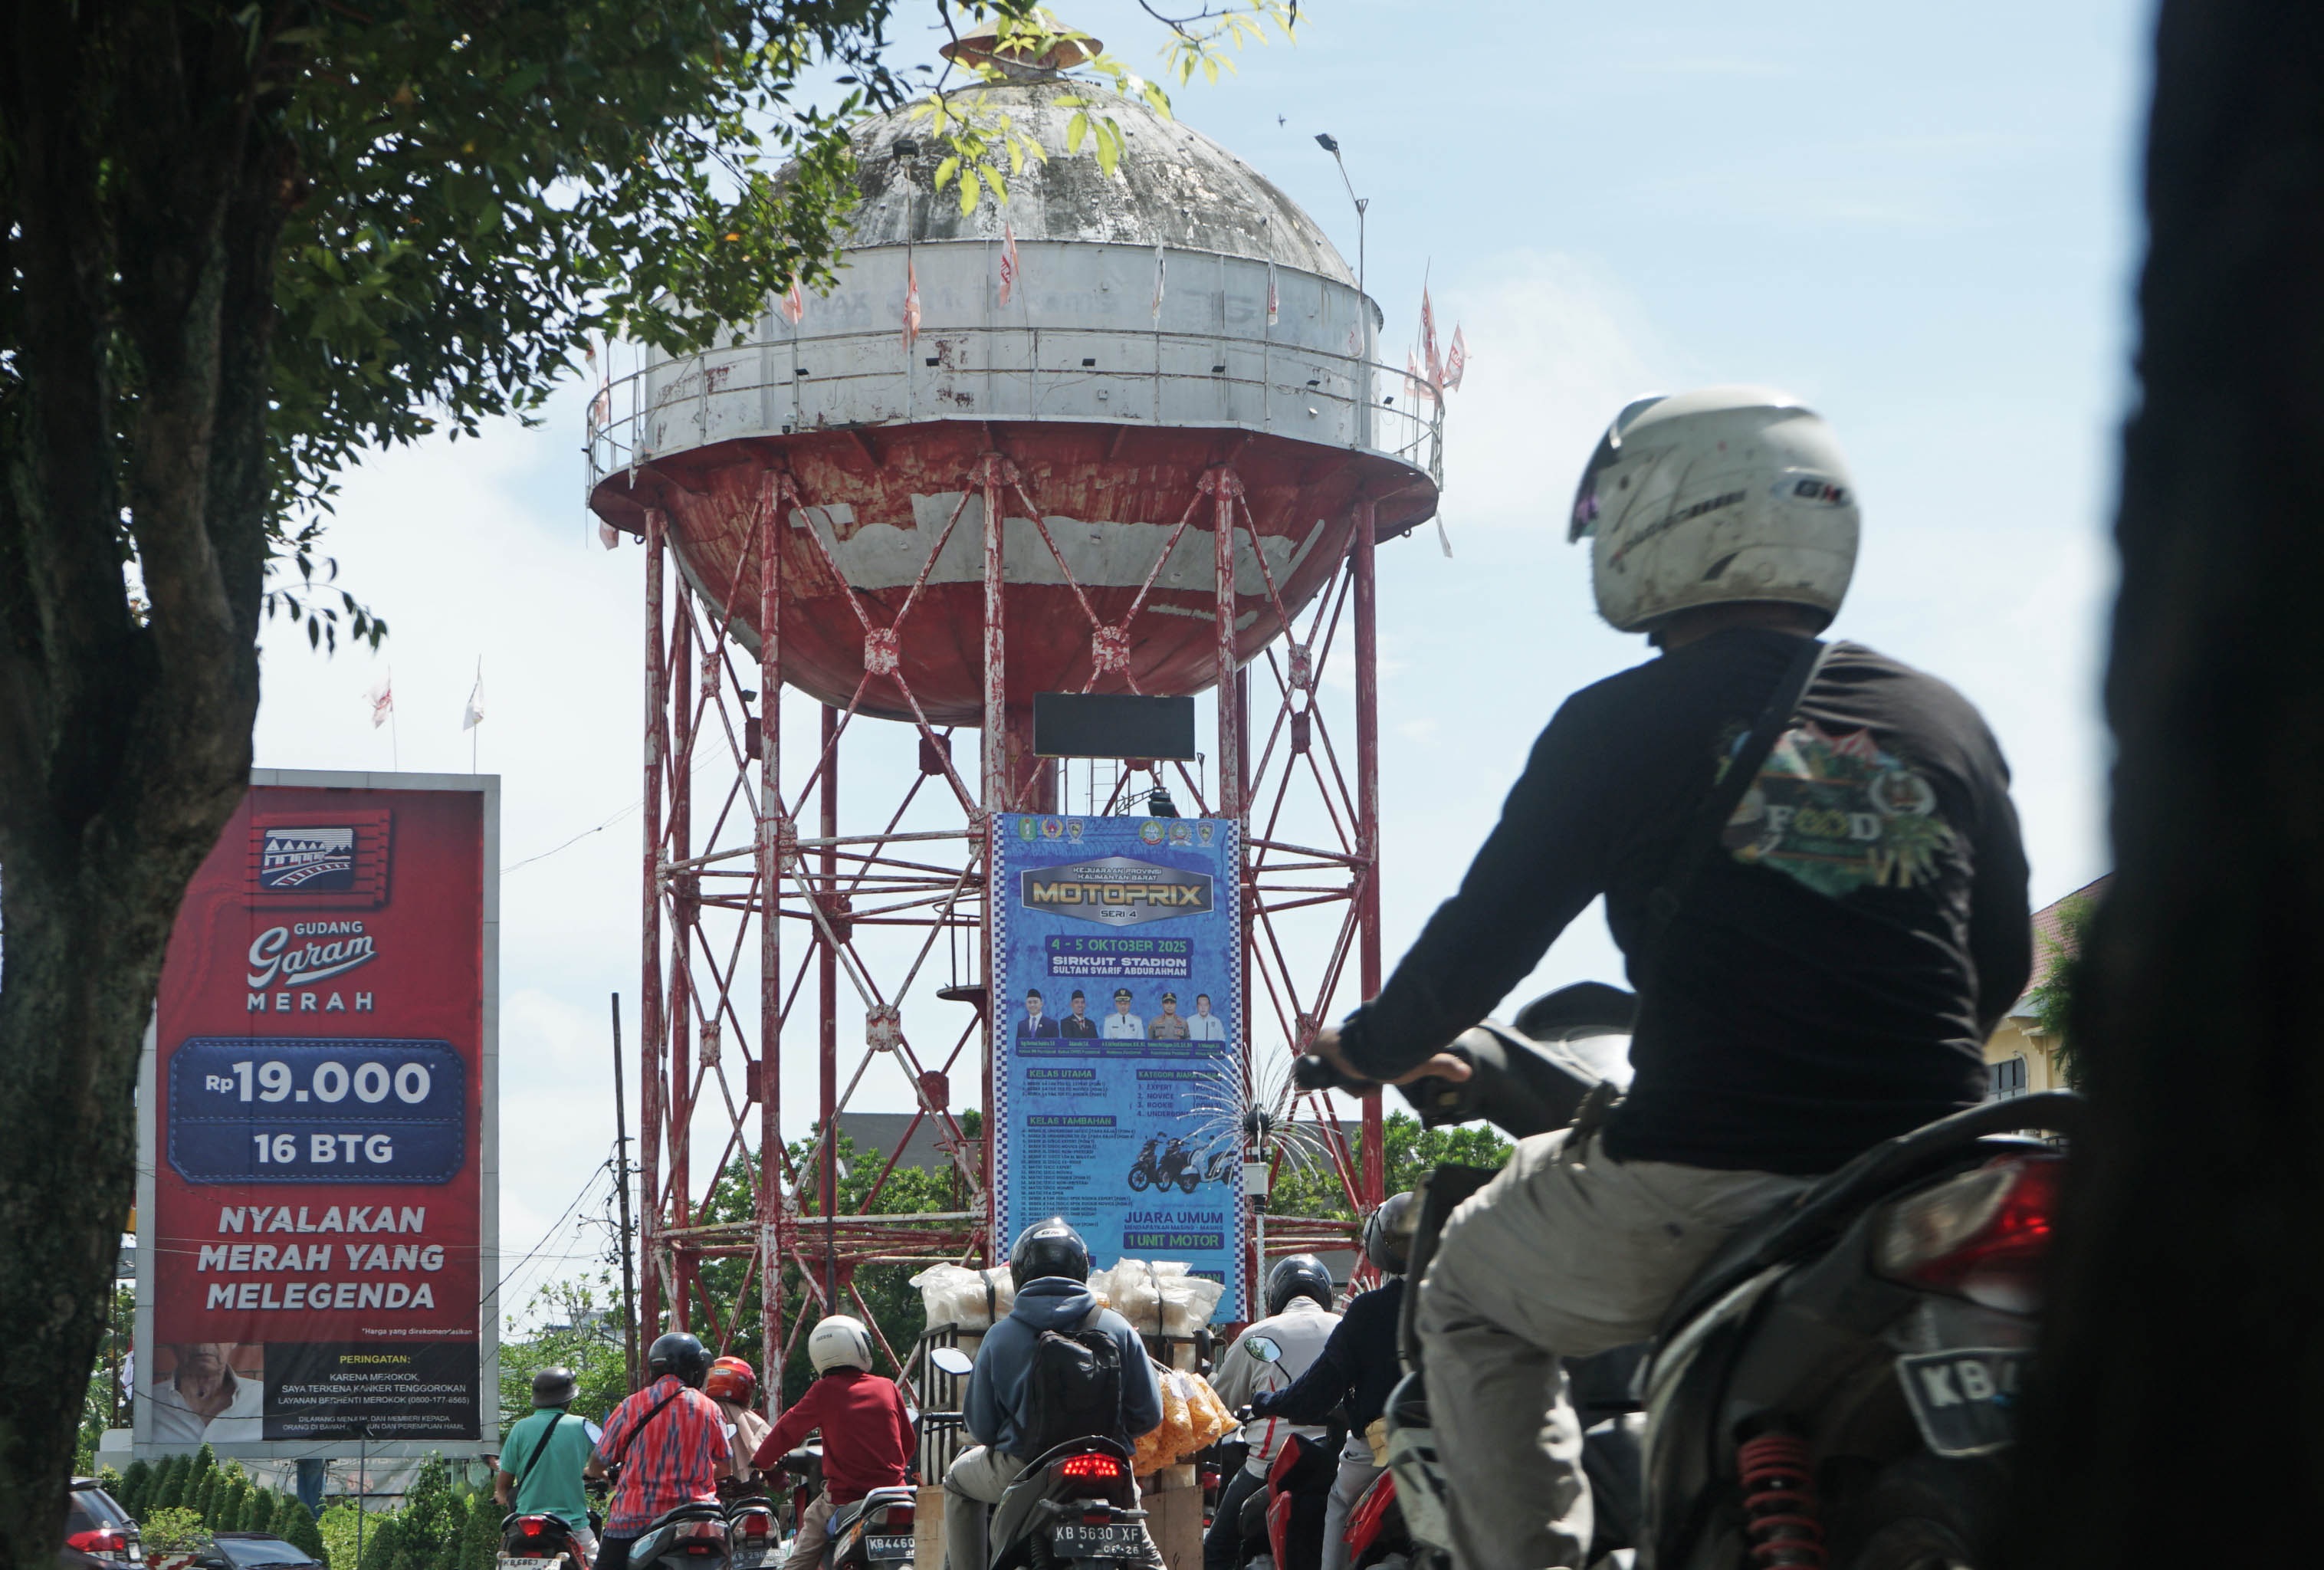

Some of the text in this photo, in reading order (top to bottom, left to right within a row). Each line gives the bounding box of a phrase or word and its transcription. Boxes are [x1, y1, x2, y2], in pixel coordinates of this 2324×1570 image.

[1032, 882, 1203, 906] MOTOPRIX
[294, 921, 363, 934] GUDANG
[1052, 938, 1060, 951] 4
[1076, 938, 1083, 951] 5
[1088, 939, 1154, 952] OKTOBER
[1158, 940, 1187, 953] 2025
[247, 926, 379, 989] Garam
[1052, 957, 1187, 967] SIRKUIT STADION
[1052, 966, 1187, 976] SULTAN SYARIF ABDURAHMAN
[247, 992, 374, 1012] MERAH
[254, 1134, 392, 1163] 16 BTG
[218, 1206, 425, 1233] NYALAKAN
[1124, 1211, 1223, 1223] JUARA UMUM
[1128, 1234, 1219, 1246] 1 UNIT MOTOR
[197, 1244, 445, 1272] MERAH YANG
[206, 1283, 435, 1310] MELEGENDA
[389, 1329, 407, 1337] yang
[340, 1355, 412, 1364] PERINGATAN:
[330, 1373, 368, 1381] KARENA
[1919, 1360, 1996, 1407] KB
[281, 1384, 307, 1393] SAYA
[308, 1384, 352, 1393] TERKENA
[393, 1384, 467, 1393] TENGGOROKAN
[278, 1396, 317, 1404] LAYANAN
[363, 1396, 406, 1404] MEROKOK
[1056, 1526, 1139, 1541] KB 5630 XF
